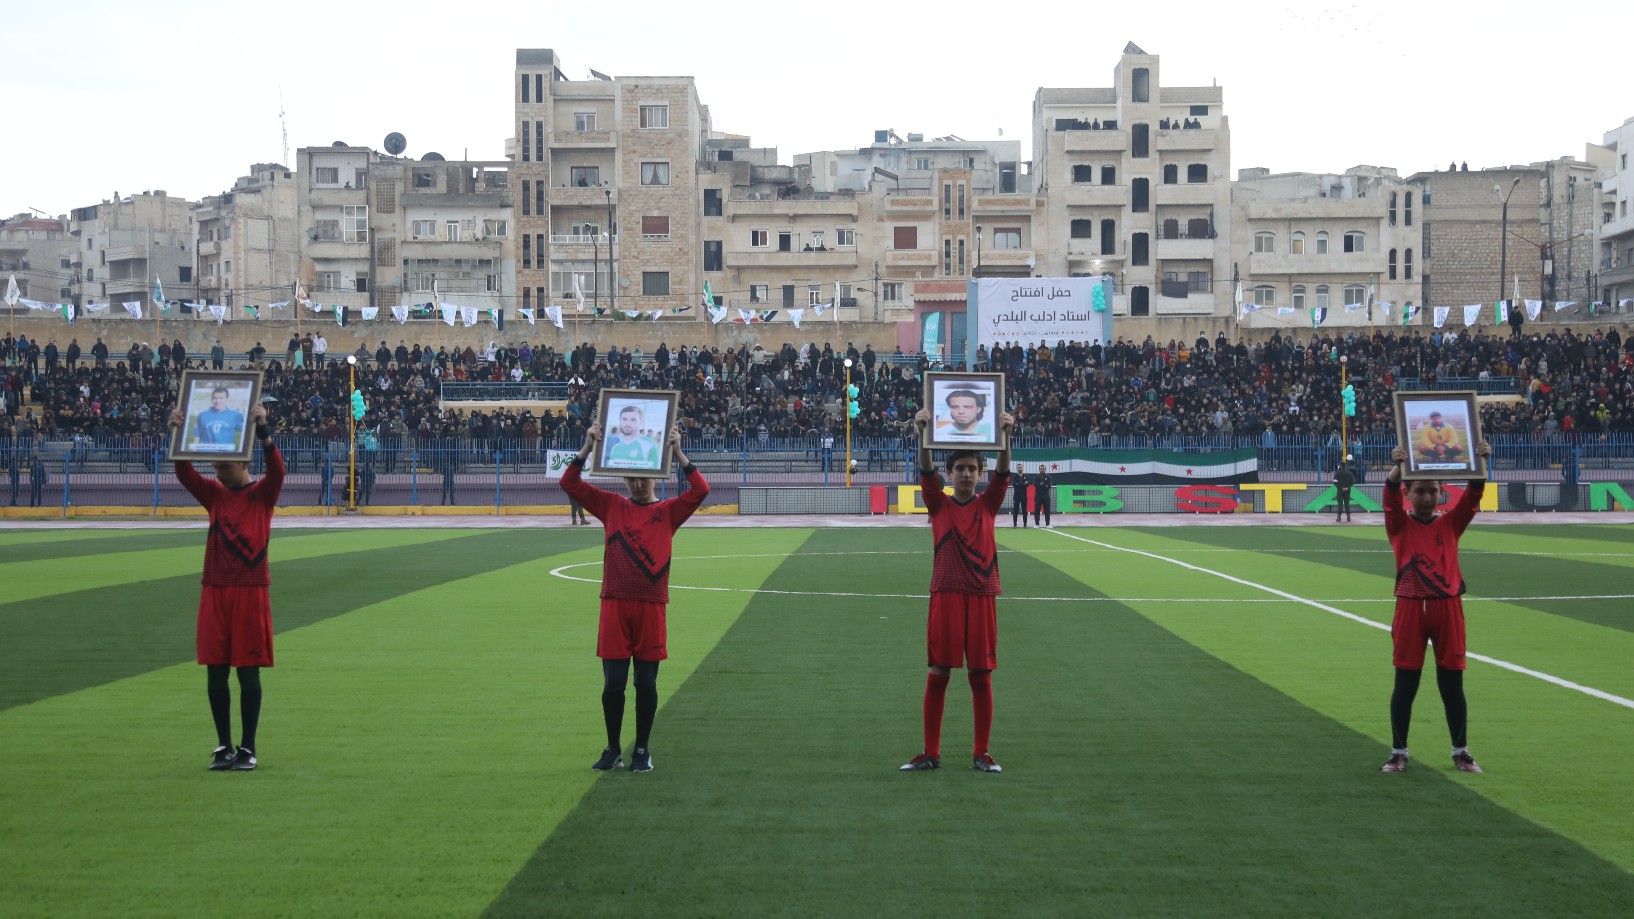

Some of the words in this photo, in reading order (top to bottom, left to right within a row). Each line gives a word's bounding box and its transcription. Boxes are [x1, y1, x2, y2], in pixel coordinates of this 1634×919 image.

[1011, 286, 1044, 302] افتتاح
[1047, 287, 1071, 300] حفل
[992, 310, 1027, 327] البلدي
[1030, 310, 1056, 324] إدلب
[1059, 310, 1090, 322] استاد
[870, 484, 1124, 513] IDIB
